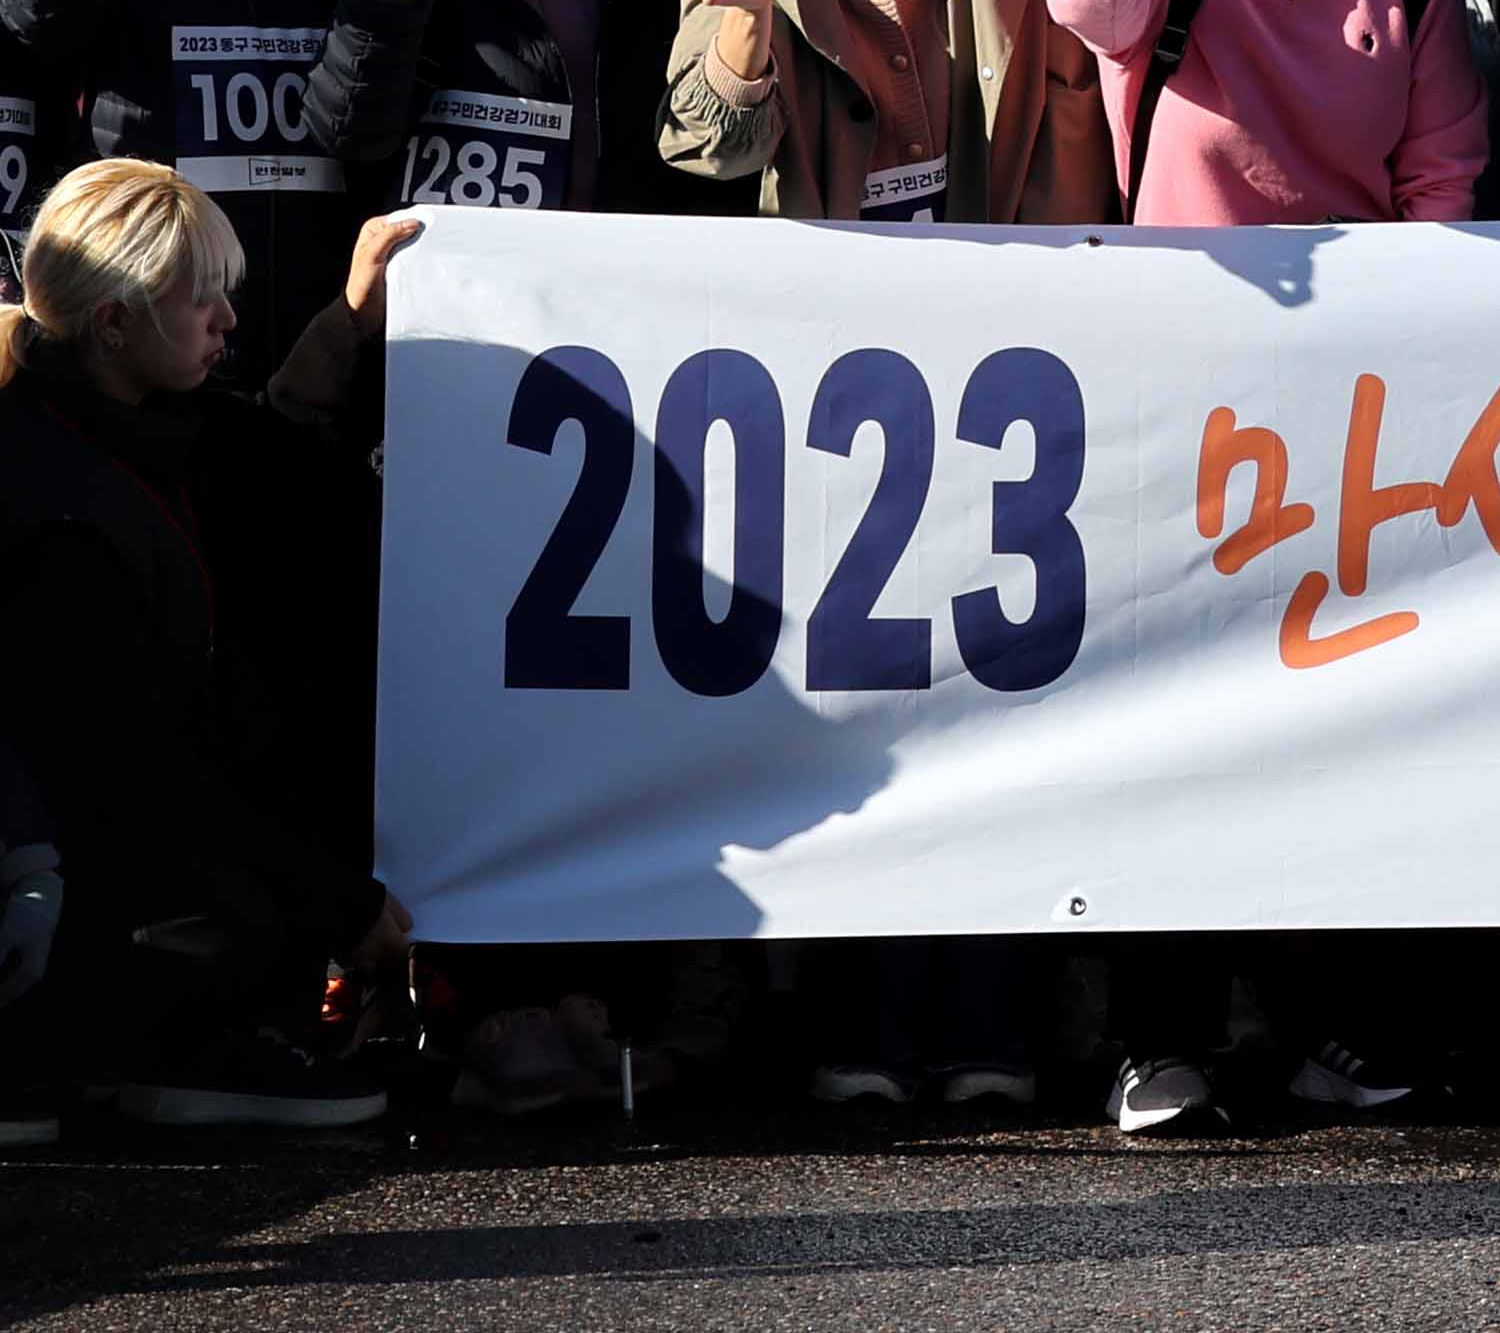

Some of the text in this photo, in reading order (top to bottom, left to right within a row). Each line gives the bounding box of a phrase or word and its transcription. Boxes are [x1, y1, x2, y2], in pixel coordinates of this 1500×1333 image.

[179, 36, 219, 53] 2023
[450, 101, 562, 131] 구민건강걷기대회
[400, 135, 547, 210] 1285
[504, 345, 1087, 697] 2023
